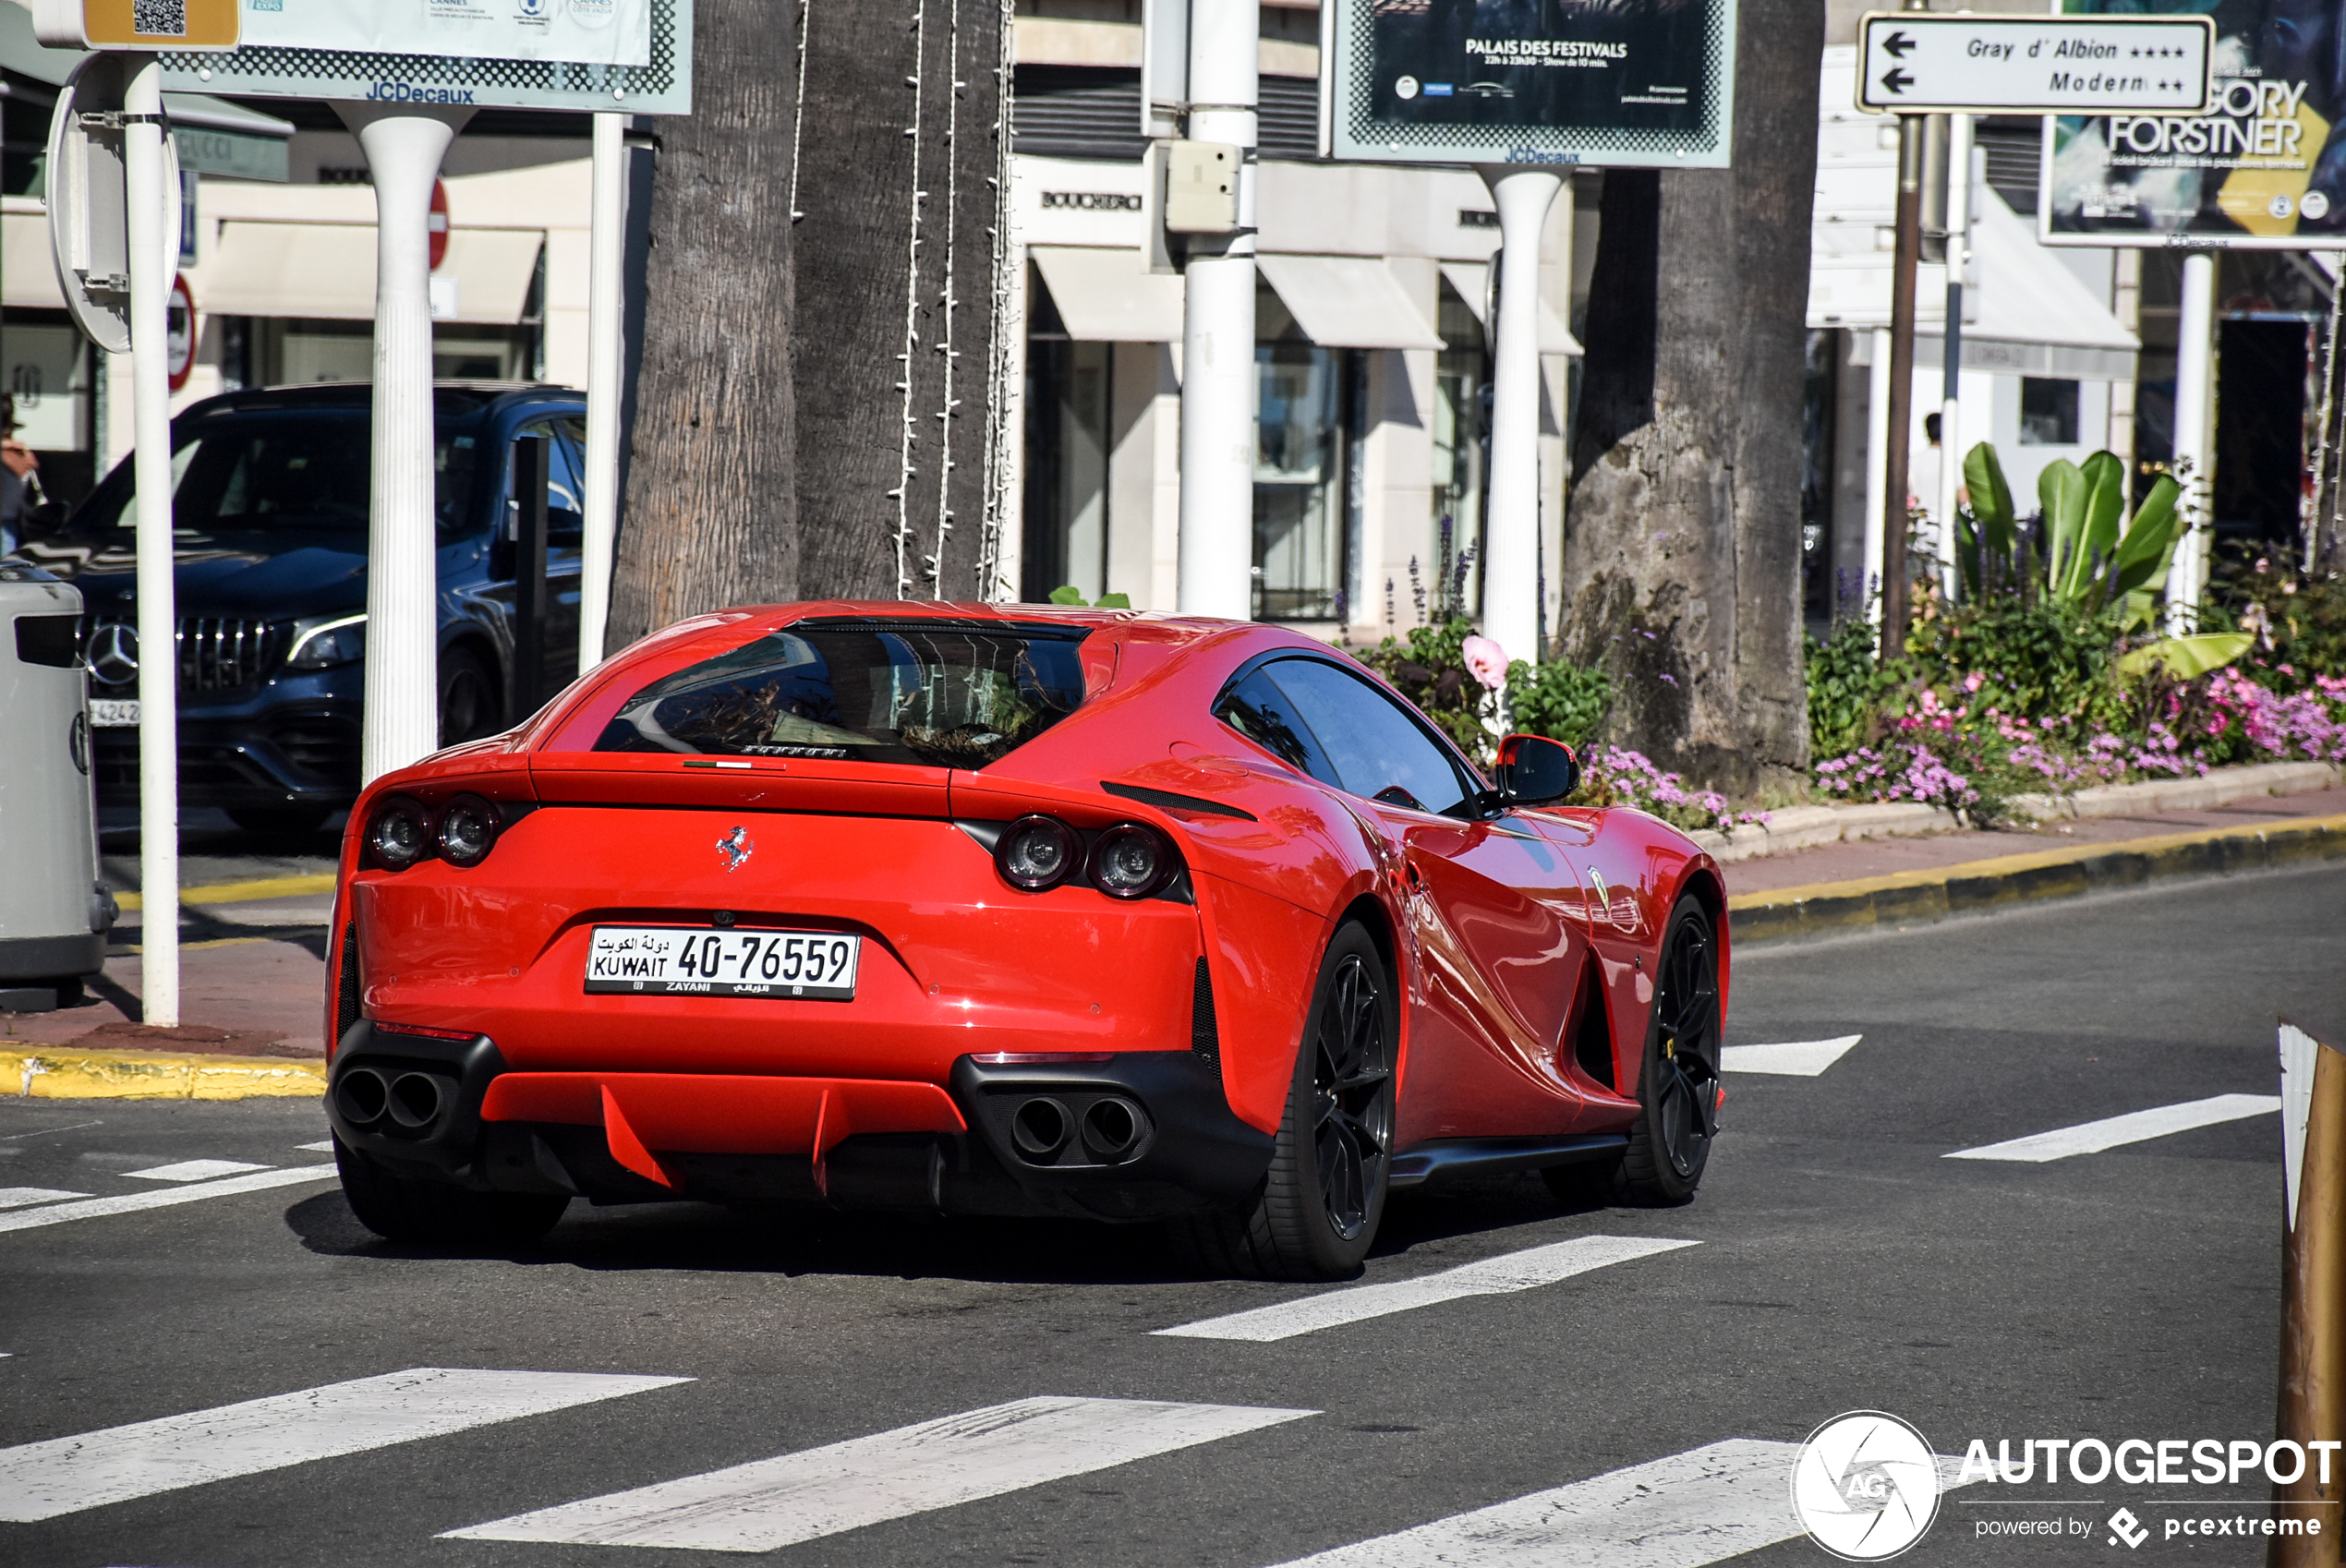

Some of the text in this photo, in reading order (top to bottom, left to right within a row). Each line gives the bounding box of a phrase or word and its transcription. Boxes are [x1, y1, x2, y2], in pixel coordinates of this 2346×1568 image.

[256, 3, 281, 11] EXPO
[1466, 39, 1627, 58] PALAIS DES FESTIVALS
[1967, 38, 2014, 62] Gray
[2054, 39, 2119, 59] Albion
[1484, 55, 1501, 65] 22h
[1508, 55, 1537, 66] 23h30
[1566, 57, 1578, 66] de
[1578, 57, 1588, 67] 10
[2050, 72, 2143, 92] Modern
[366, 81, 474, 103] JCDecaux
[2203, 78, 2308, 117] GORY
[2109, 116, 2303, 155] FORSTNER
[1506, 148, 1580, 164] JCDecaux
[2162, 233, 2230, 248] JCDecaux
[597, 935, 669, 954] دولة الكويت
[593, 957, 668, 978] KUWAIT
[678, 935, 850, 983] 40-76559
[666, 982, 710, 992] ZAYANI
